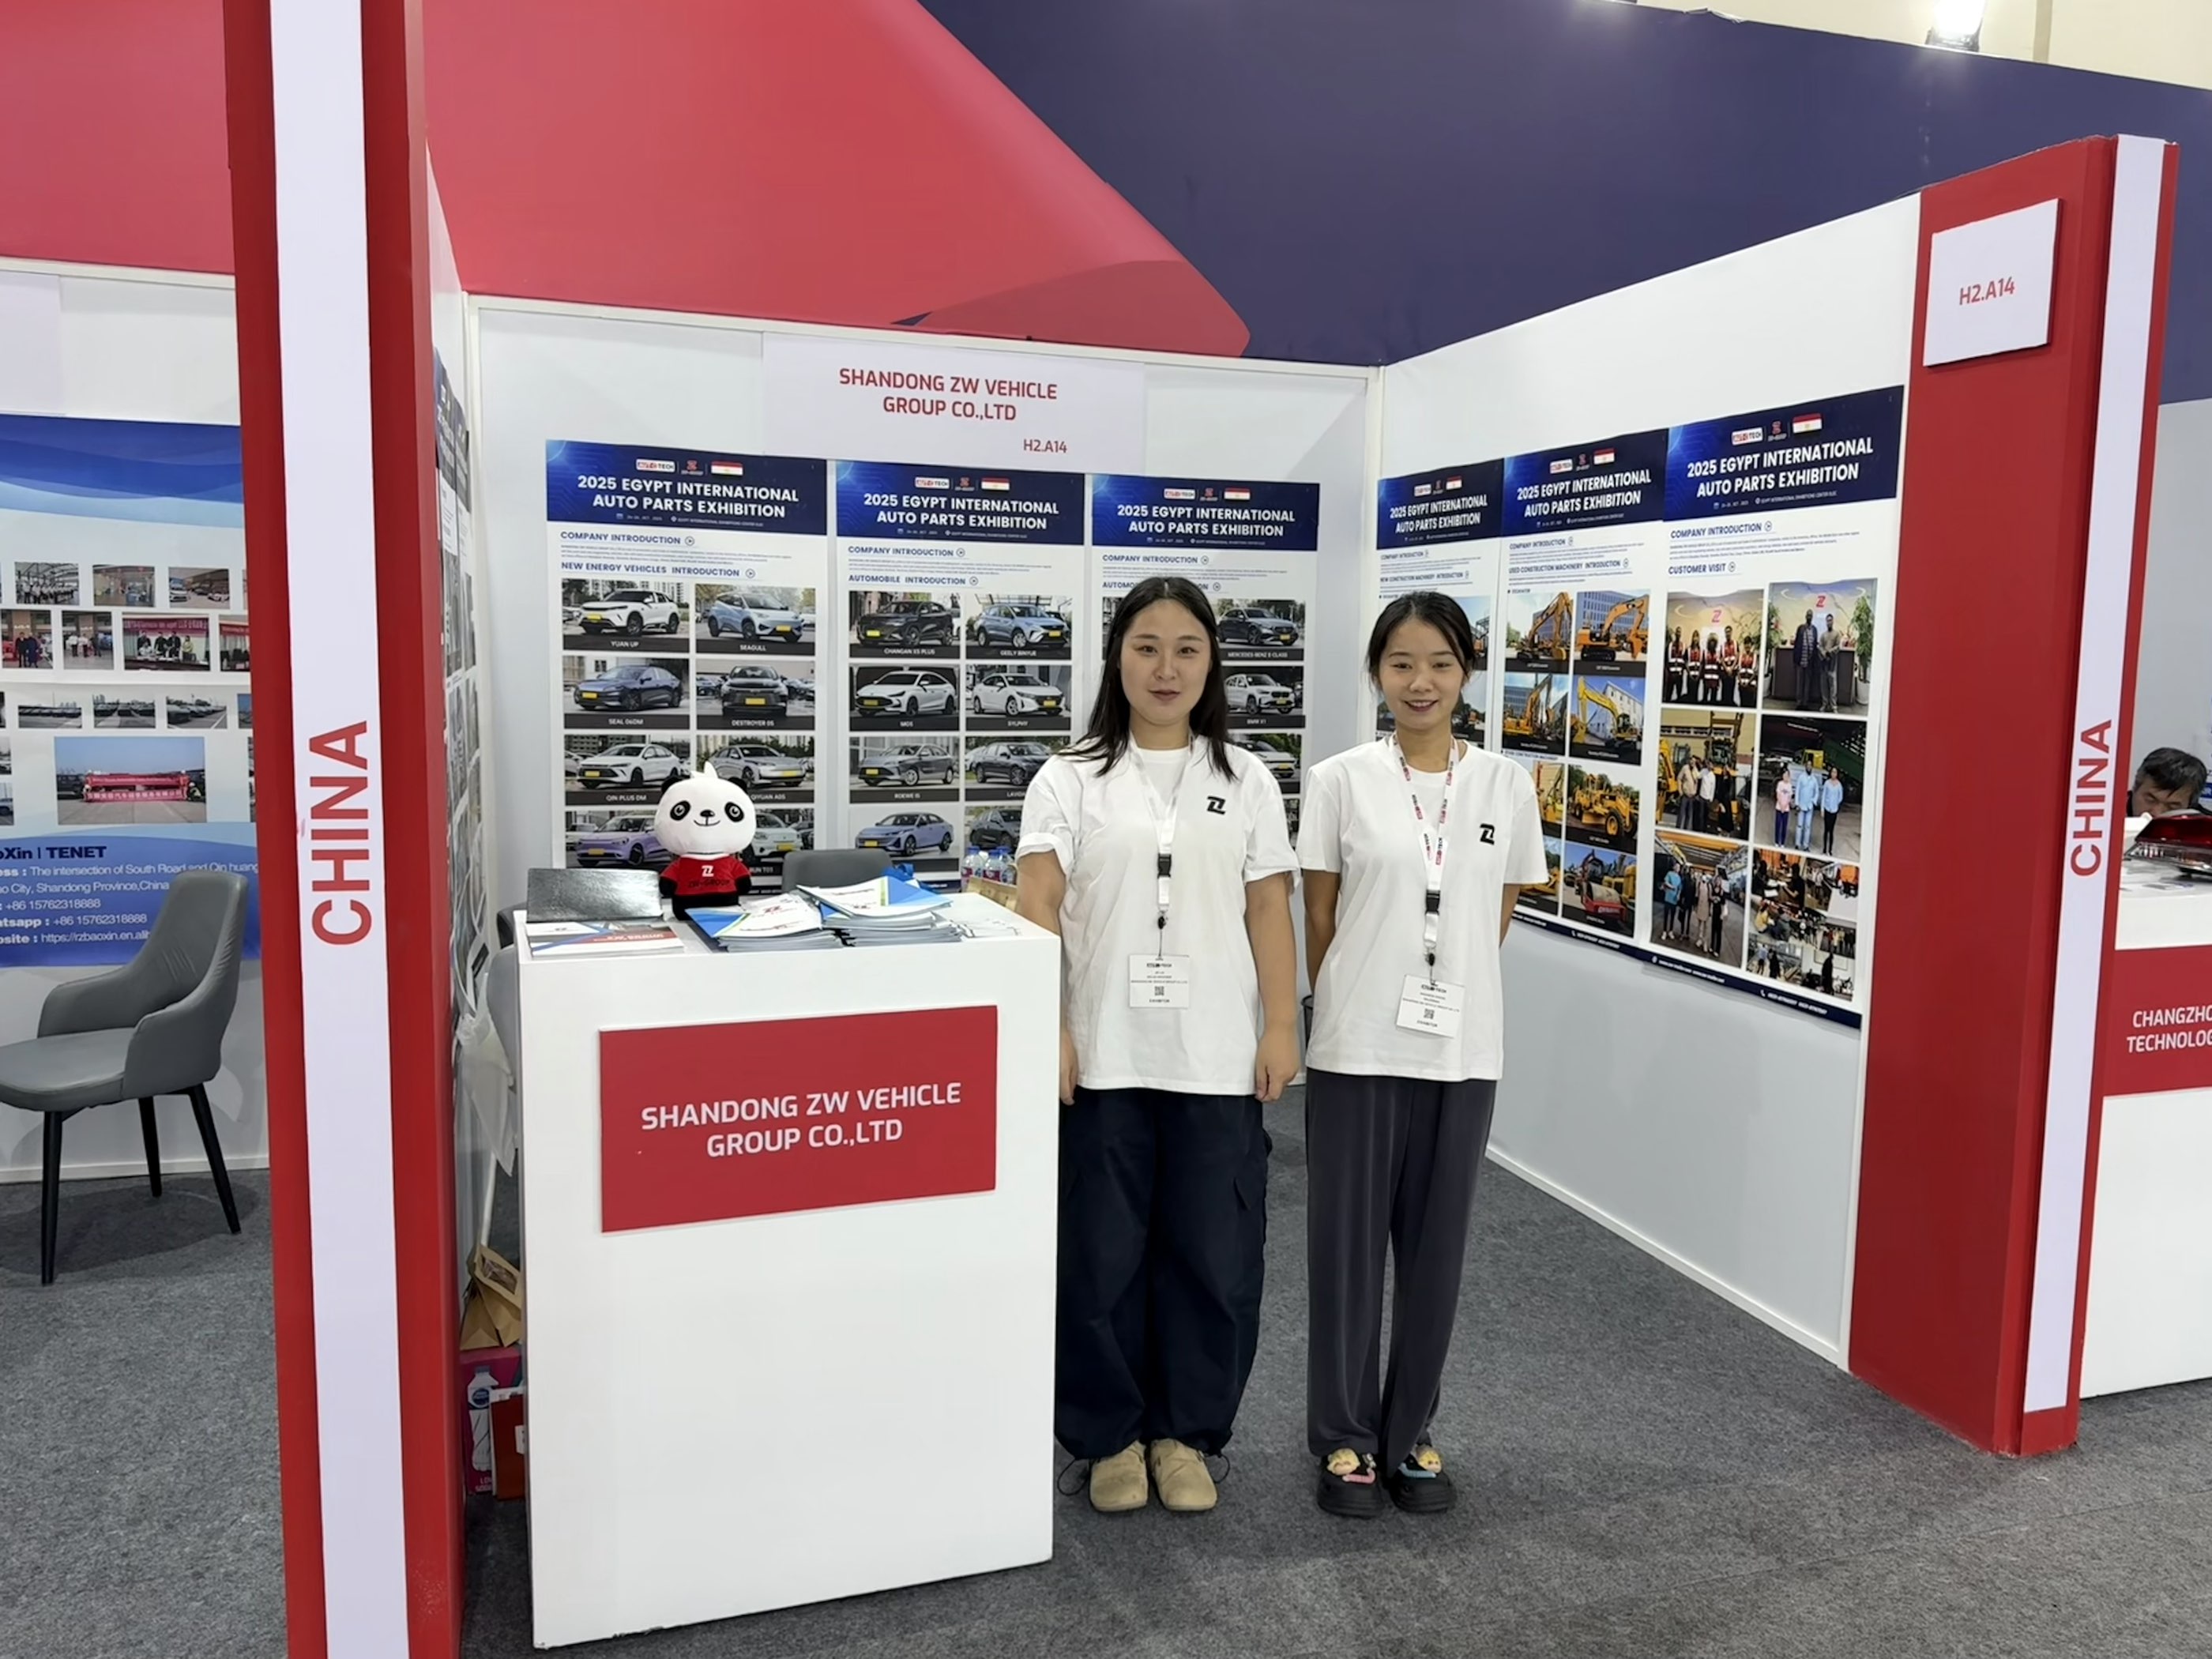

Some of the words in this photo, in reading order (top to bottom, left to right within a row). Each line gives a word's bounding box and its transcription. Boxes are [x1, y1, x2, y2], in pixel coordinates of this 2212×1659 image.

[1959, 276, 2014, 306] H2.A14
[839, 367, 945, 392] SHANDONG
[950, 376, 980, 394] ZW
[984, 379, 1058, 400] VEHICLE
[882, 396, 946, 416] GROUP
[951, 401, 1017, 420] CO.,LTD
[1023, 438, 1068, 453] H2.A14
[1687, 459, 1717, 477] 2025
[1720, 453, 1761, 474] EGYPT
[1762, 437, 1873, 468] INTERNATIONAL
[577, 475, 617, 491] 2025
[622, 479, 672, 495] EGYPT
[677, 482, 799, 502] INTERNATIONAL
[1517, 485, 1540, 500] 2025
[1540, 481, 1571, 498] EGYPT
[1572, 469, 1651, 493] INTERNATIONAL
[1697, 479, 1732, 498] AUTO
[1734, 473, 1775, 493] PARTS
[1778, 462, 1859, 488] EXHIBITION
[592, 494, 638, 510] AUTO
[643, 497, 693, 513] PARTS
[698, 501, 785, 518] EXHIBITION
[863, 493, 898, 506] 2025
[902, 496, 946, 510] EGYPT
[950, 498, 1059, 514] INTERNATIONAL
[1117, 505, 1148, 517] 2025
[1152, 506, 1193, 519] EGYPT
[1196, 508, 1295, 522] INTERNATIONAL
[1390, 506, 1407, 519] 2025
[1408, 503, 1429, 517] EGYPT
[1430, 495, 1488, 514] INTERNATIONAL
[1524, 502, 1550, 517] AUTO
[1551, 498, 1581, 514] PARTS
[1583, 491, 1642, 510] EXHIBITION
[876, 510, 917, 524] AUTO
[920, 512, 965, 527] PARTS
[969, 515, 1047, 529] EXHIBITION
[1128, 521, 1165, 533] AUTO
[1168, 523, 1209, 535] PARTS
[1212, 524, 1284, 536] EXHIBITION
[1395, 522, 1415, 533] AUTO
[1415, 518, 1438, 532] PARTS
[1439, 513, 1481, 529] EXHIBITION
[560, 531, 608, 541] COMPANY
[611, 533, 681, 544] INTRODUCTION
[1670, 528, 1706, 539] COMPANY
[1708, 522, 1762, 536] INTRODUCTION
[848, 546, 890, 555] COMPANY
[893, 547, 954, 557] INTRODUCTION
[1510, 541, 1532, 550] COMPANY
[1533, 539, 1566, 548] INTRODUCTION
[561, 562, 584, 570] NEW
[585, 562, 622, 572] ENERGY
[624, 564, 667, 574] VEHICLES
[672, 566, 740, 577] INTRODUCTION
[1142, 555, 1198, 564] INTRODUCTION
[1520, 565, 1555, 574] CONSTRUCTION
[1585, 560, 1620, 569] INTRODUCTION
[1668, 563, 1707, 574] CUSTOMER
[1709, 562, 1726, 573] VISIT
[848, 574, 900, 583] AUTOMOBILE
[905, 577, 966, 585] INTRODUCTION
[739, 644, 766, 653] SEAGULL
[2070, 719, 2112, 877] CHINA
[309, 720, 372, 945] CHINA
[46, 846, 107, 860] TENET
[29, 866, 51, 876] The
[53, 865, 111, 875] intersection
[113, 865, 123, 875] of
[125, 863, 156, 875] South
[158, 863, 186, 874] Road
[36, 882, 91, 894] Shandong
[2132, 1005, 2212, 1028] CHANGZHO
[2127, 1029, 2212, 1053] TECHNOLOG
[641, 1095, 798, 1130] SHANDONG
[807, 1091, 849, 1116] ZW
[856, 1082, 961, 1112] VEHICLE
[706, 1126, 801, 1158] GROUP
[808, 1119, 903, 1149] CO.,LTD
